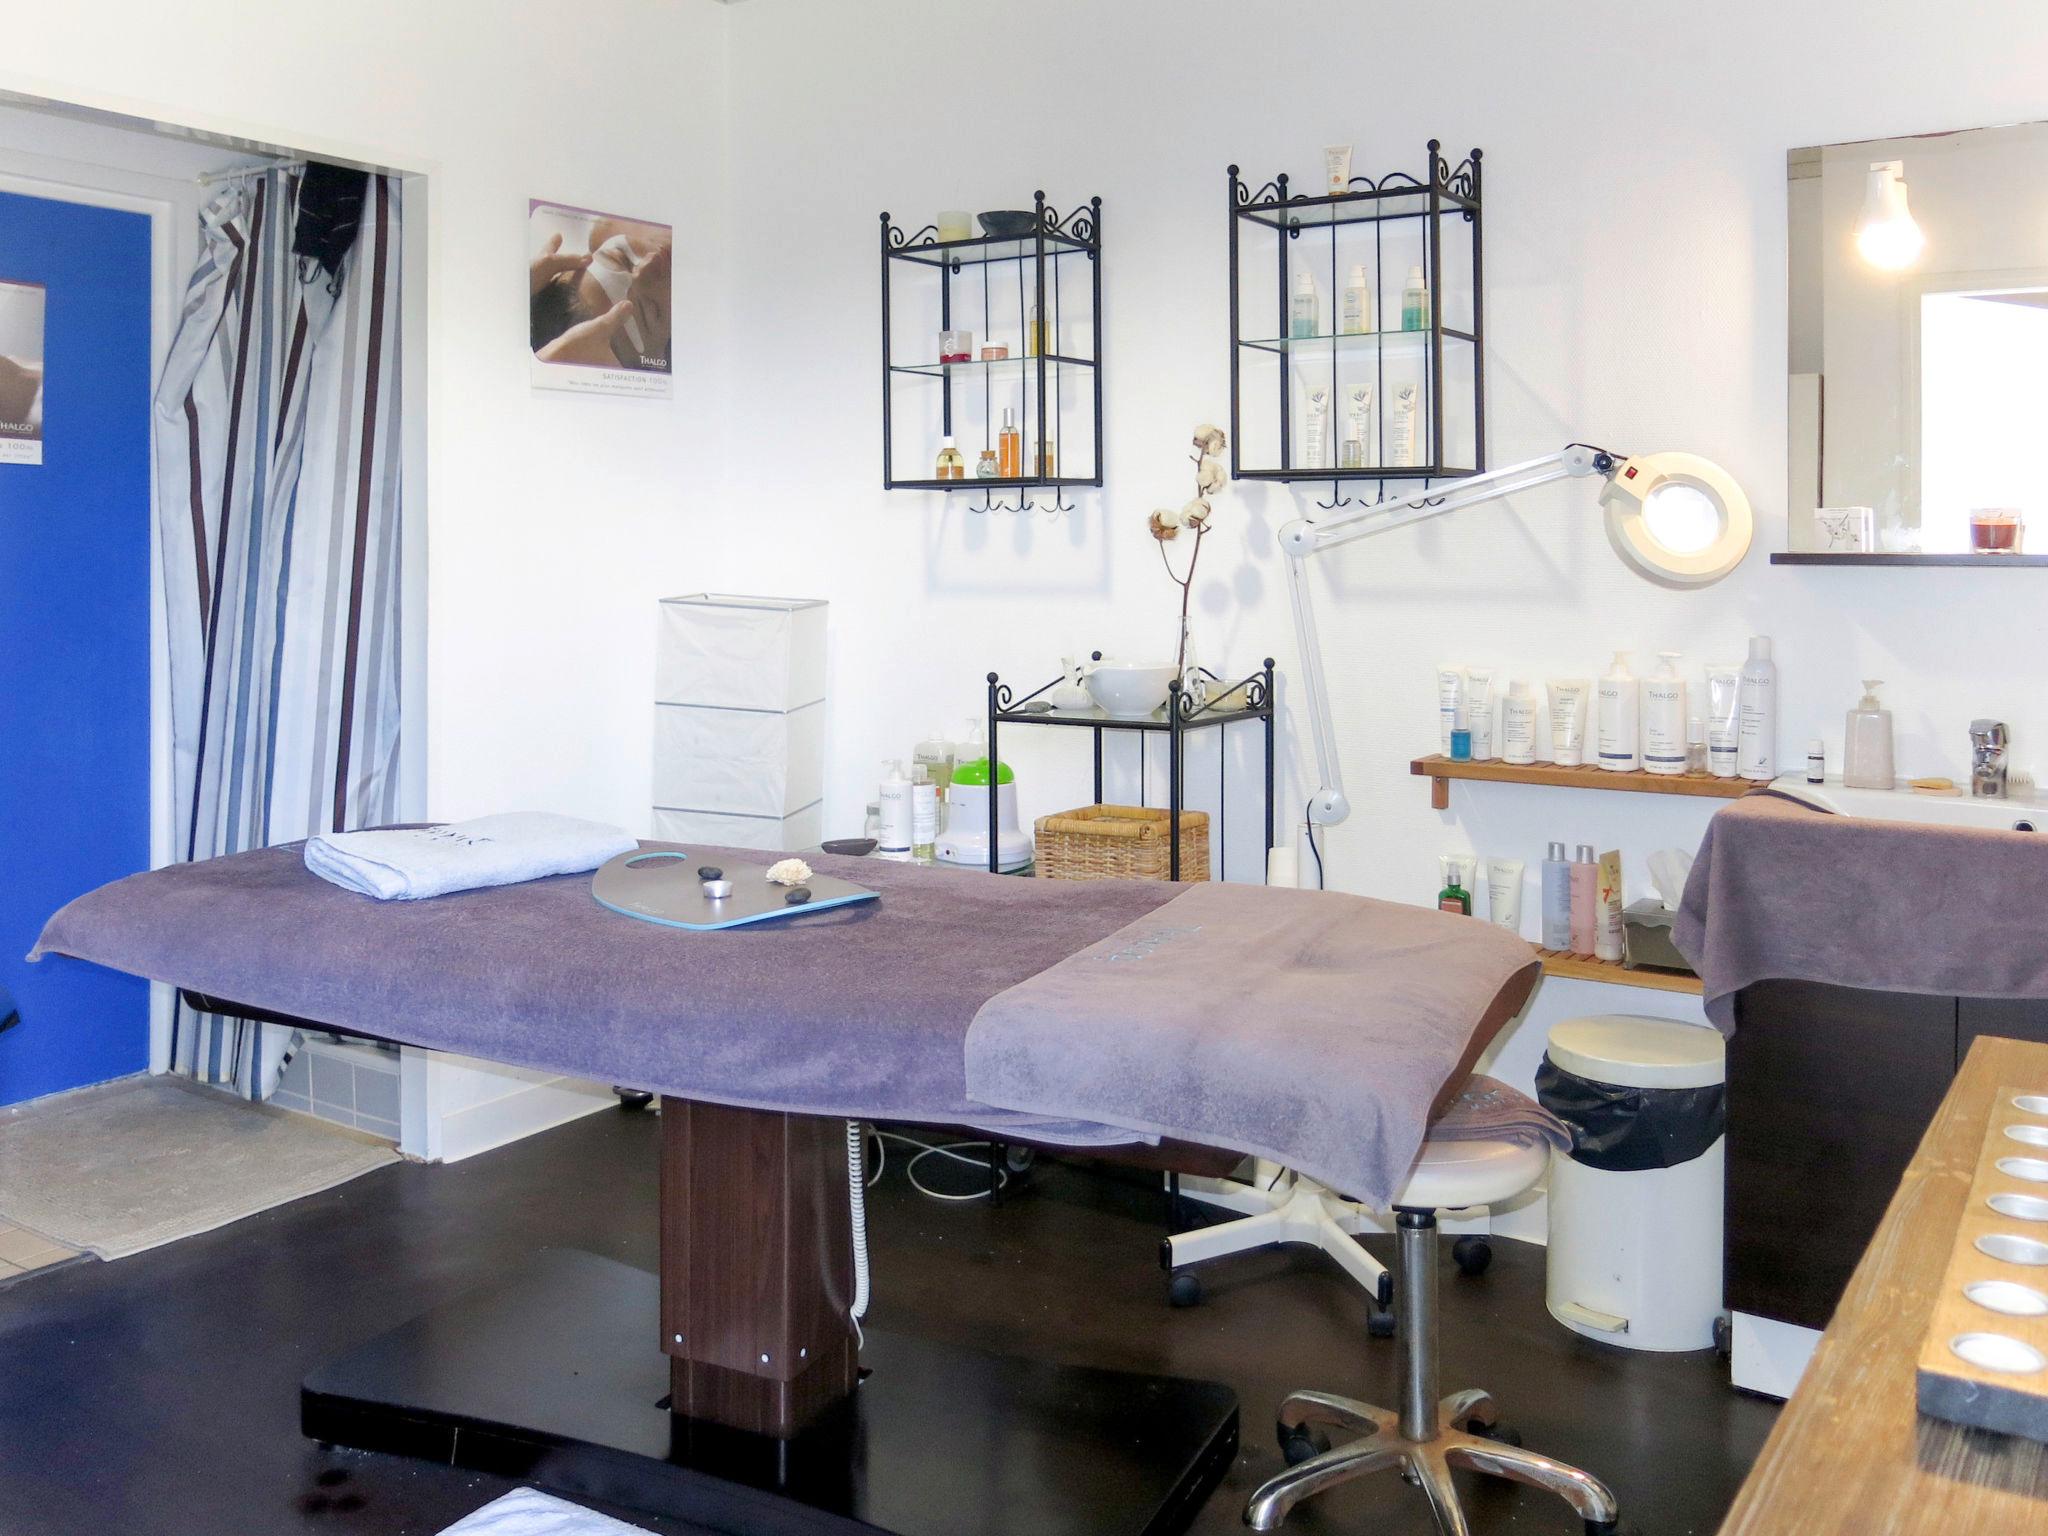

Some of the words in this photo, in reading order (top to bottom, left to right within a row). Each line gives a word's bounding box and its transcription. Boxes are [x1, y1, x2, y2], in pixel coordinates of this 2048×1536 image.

[639, 355, 667, 366] THALGO
[602, 373, 646, 383] SATISFACTION
[1648, 690, 1680, 700] THALGO
